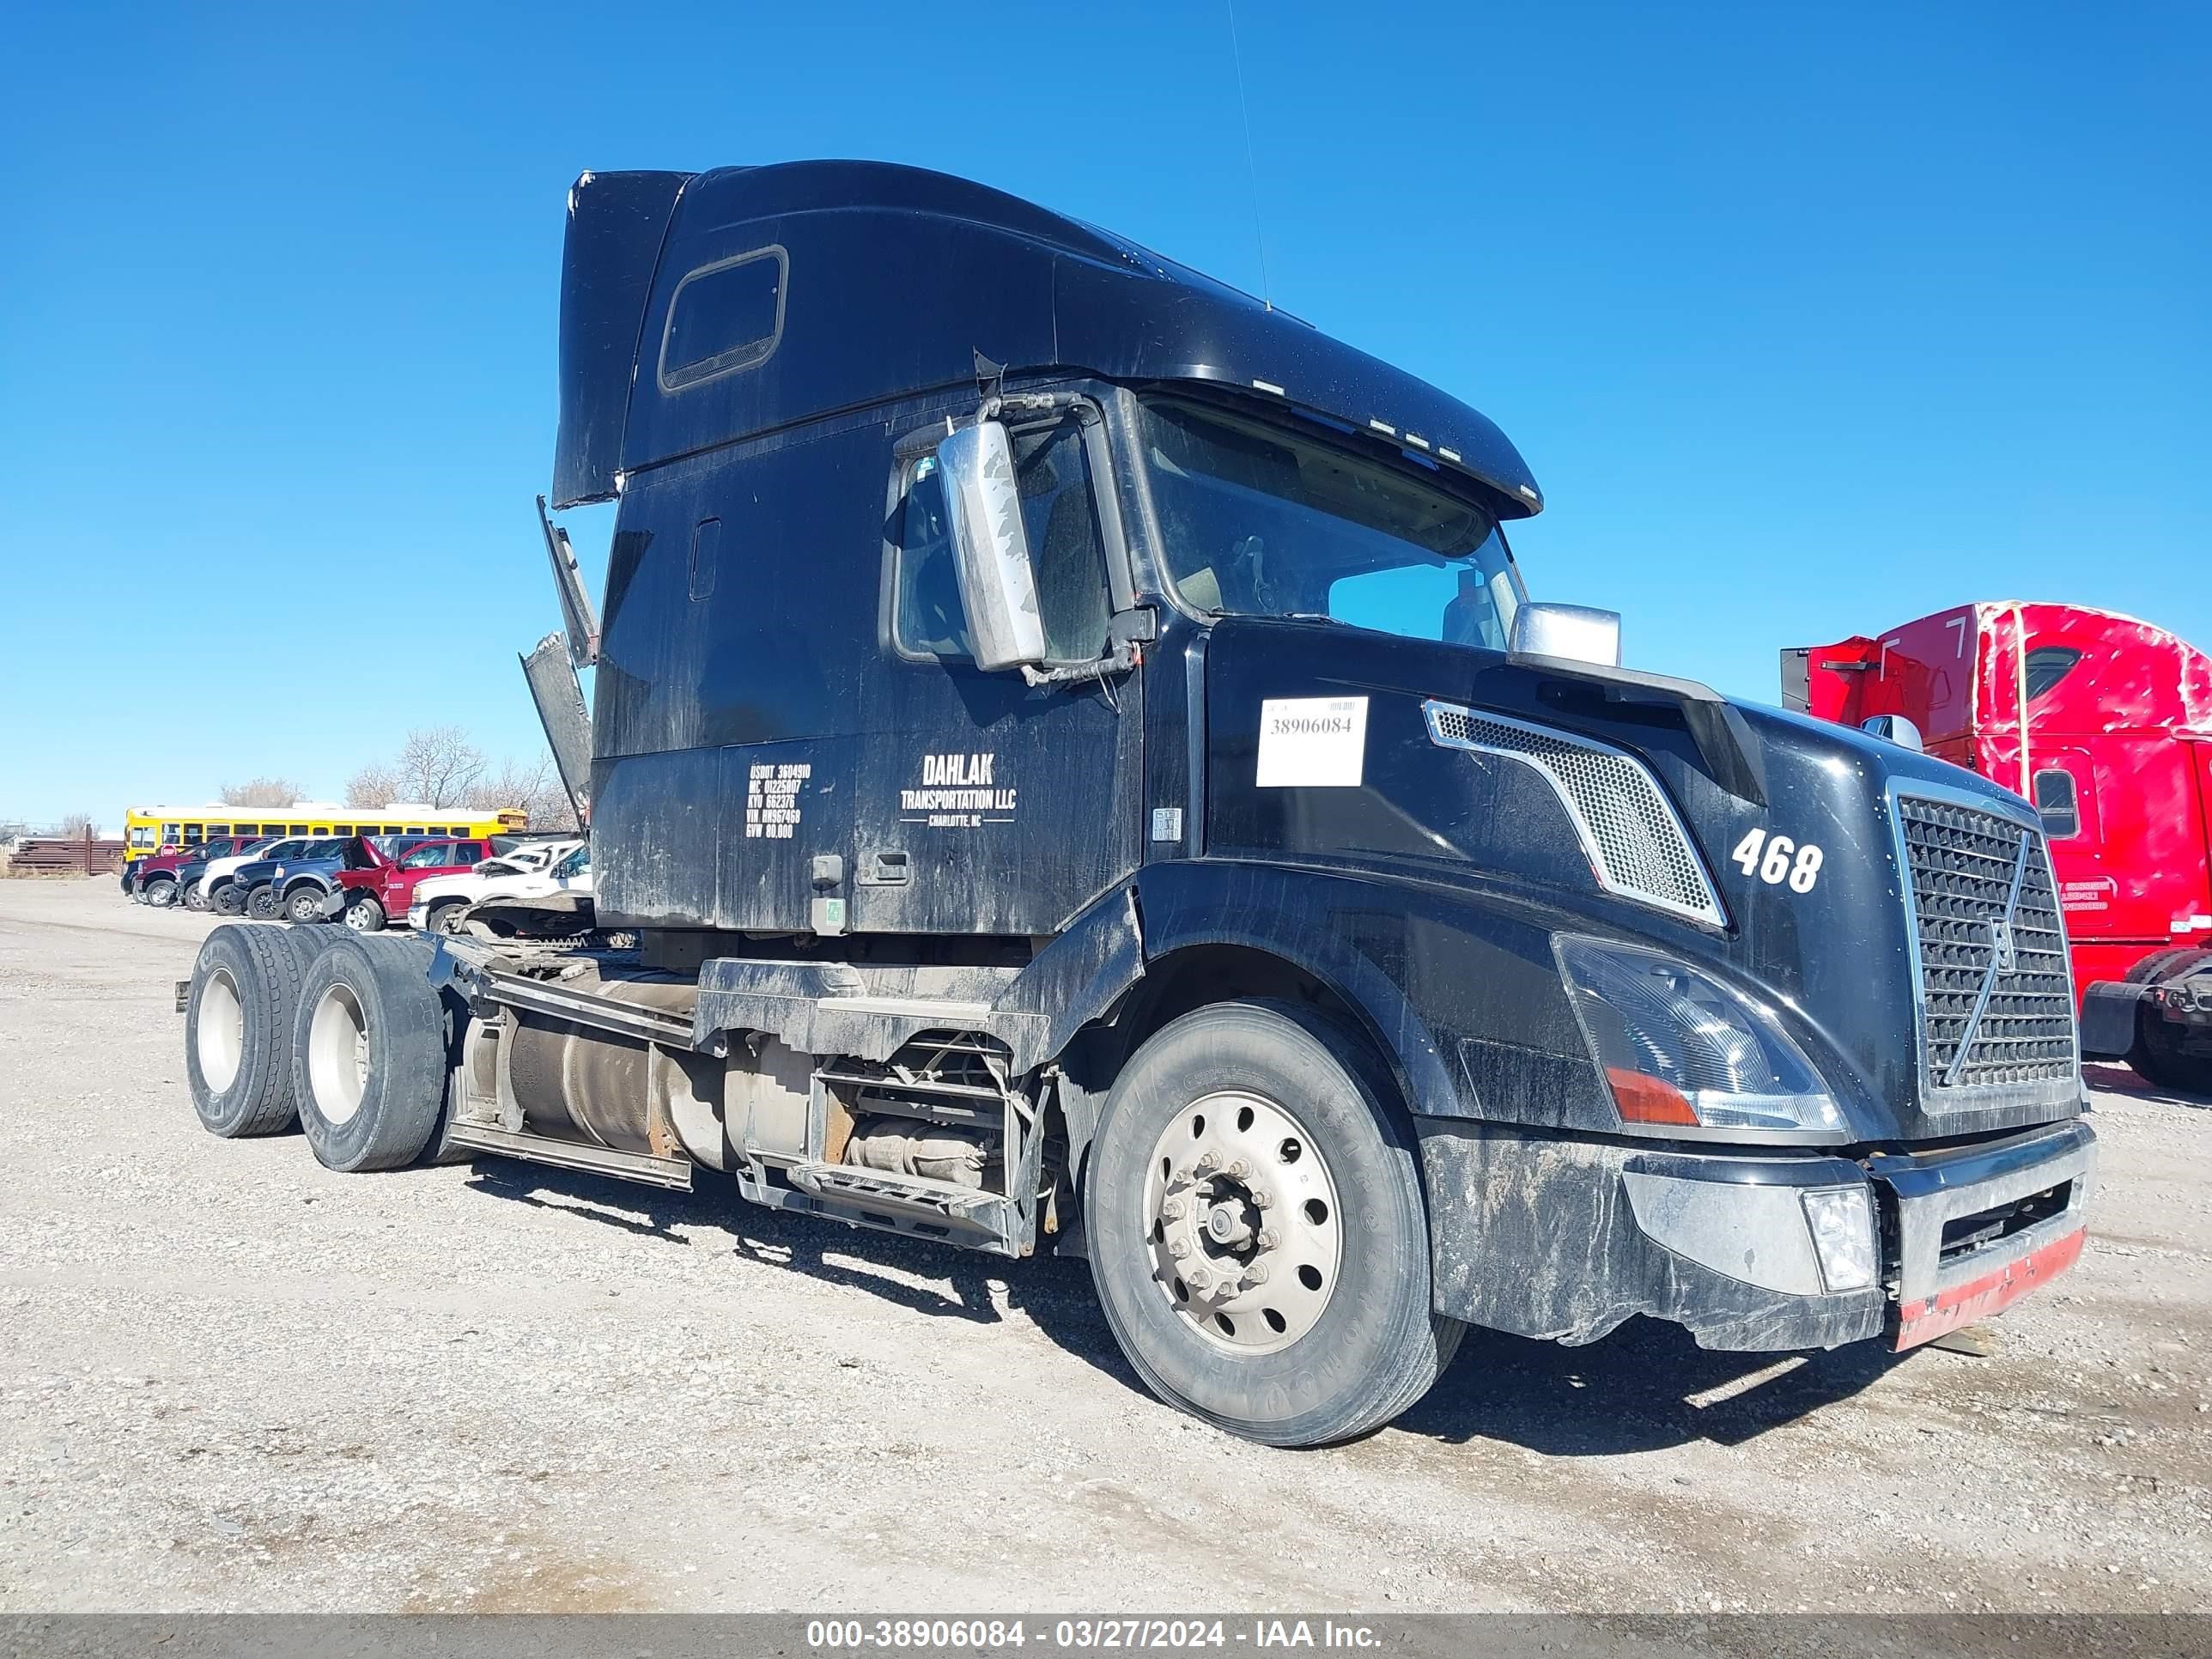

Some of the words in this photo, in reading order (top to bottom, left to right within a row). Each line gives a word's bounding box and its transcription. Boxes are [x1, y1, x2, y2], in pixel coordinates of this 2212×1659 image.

[1271, 717, 1352, 735] 38906084
[750, 765, 775, 780] USDOT
[777, 764, 811, 779] 3604910
[923, 754, 994, 786] DAHLAK
[749, 780, 761, 793] MC
[747, 794, 763, 808] KYU
[766, 794, 795, 808] 662376
[901, 789, 994, 810] TRANSPORTATION
[995, 788, 1017, 810] LLC
[746, 809, 759, 823] VIN
[971, 815, 981, 827] NC
[746, 823, 763, 838] GVW
[1731, 827, 1824, 894] 468
